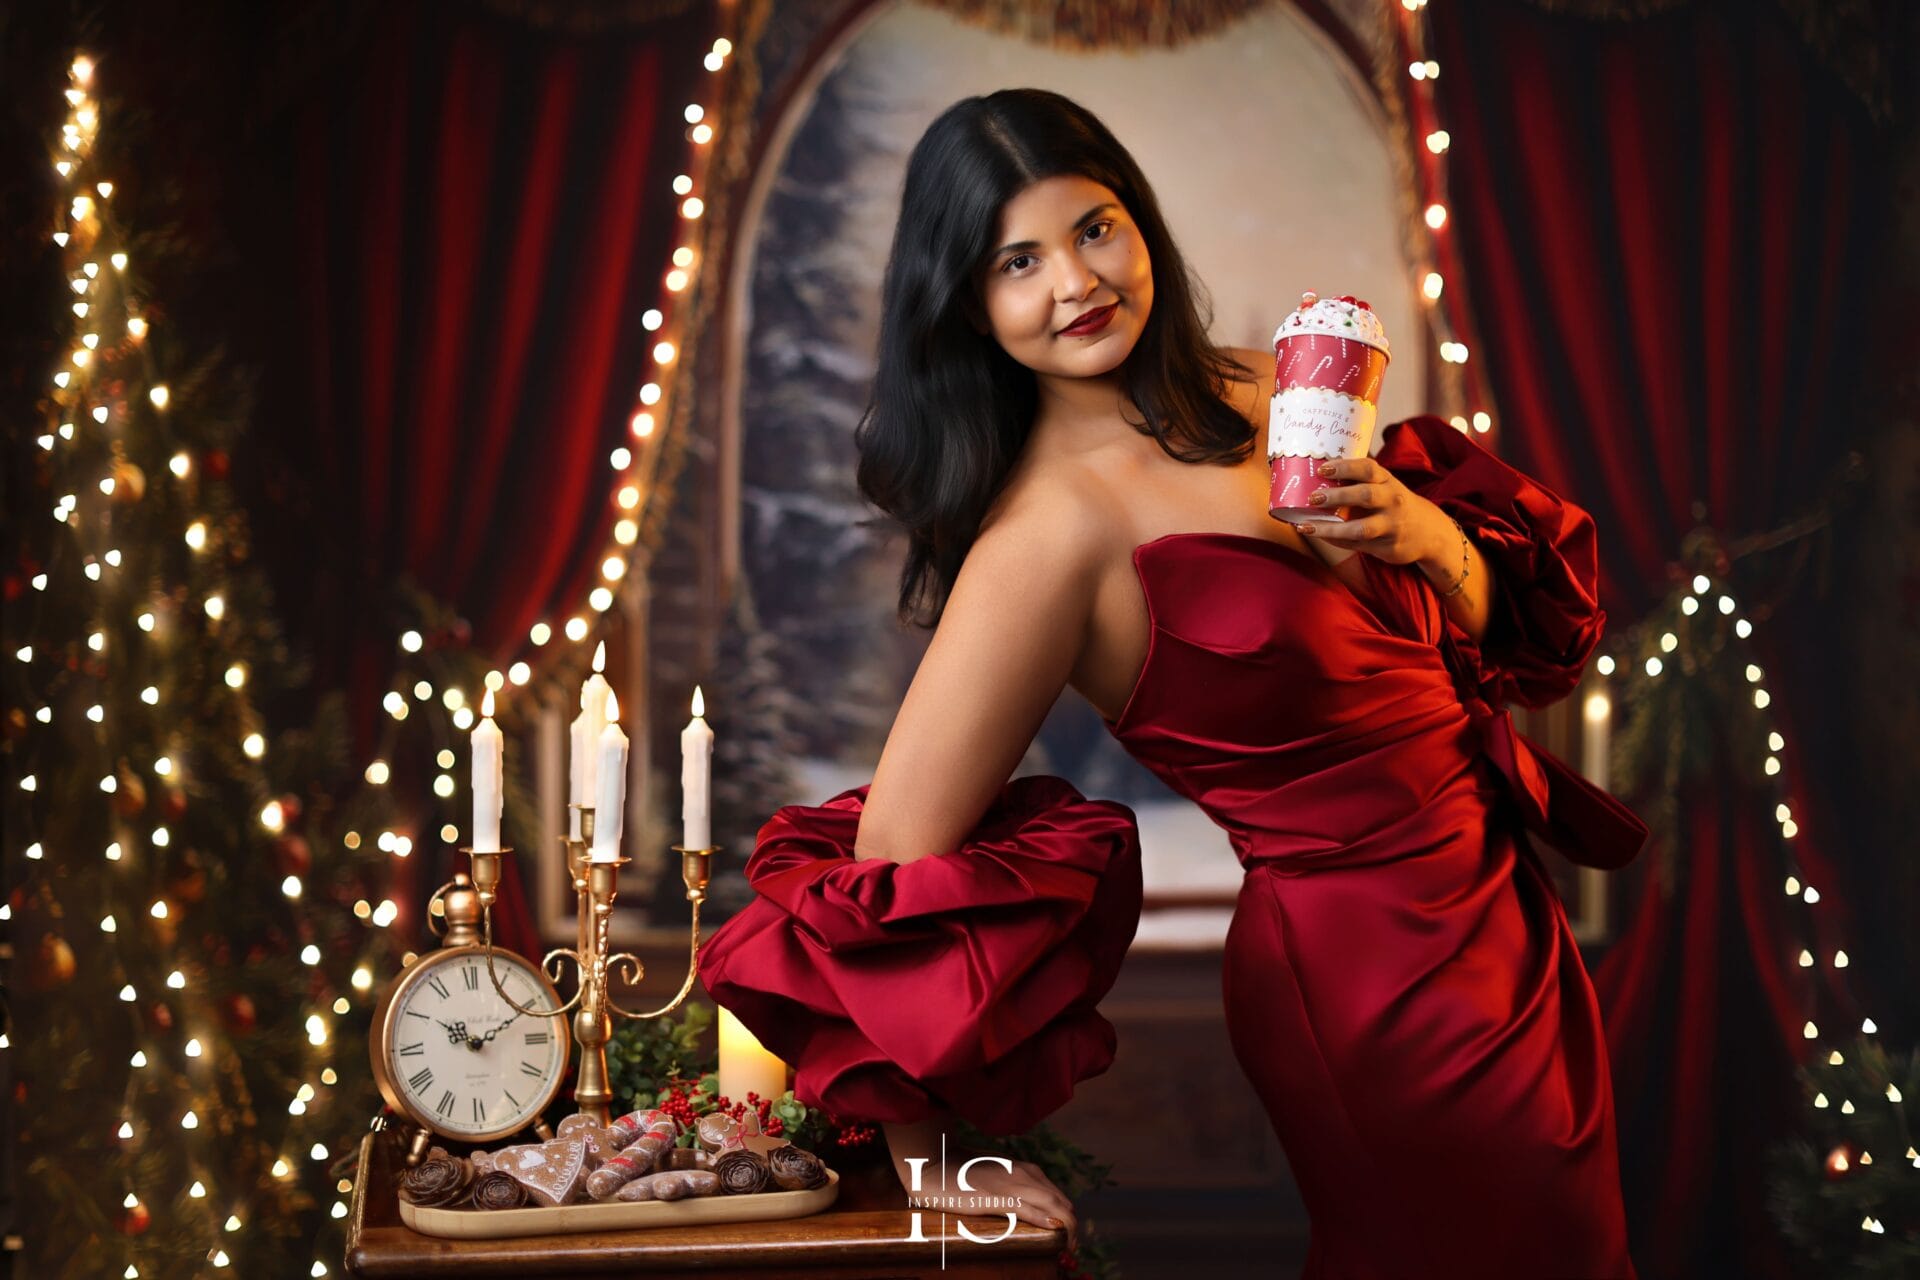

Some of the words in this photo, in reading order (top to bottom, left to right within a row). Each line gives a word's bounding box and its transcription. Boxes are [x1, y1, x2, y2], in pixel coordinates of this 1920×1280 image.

[1284, 414, 1325, 437] Candy
[1330, 421, 1362, 441] Canes
[525, 1033, 548, 1045] III
